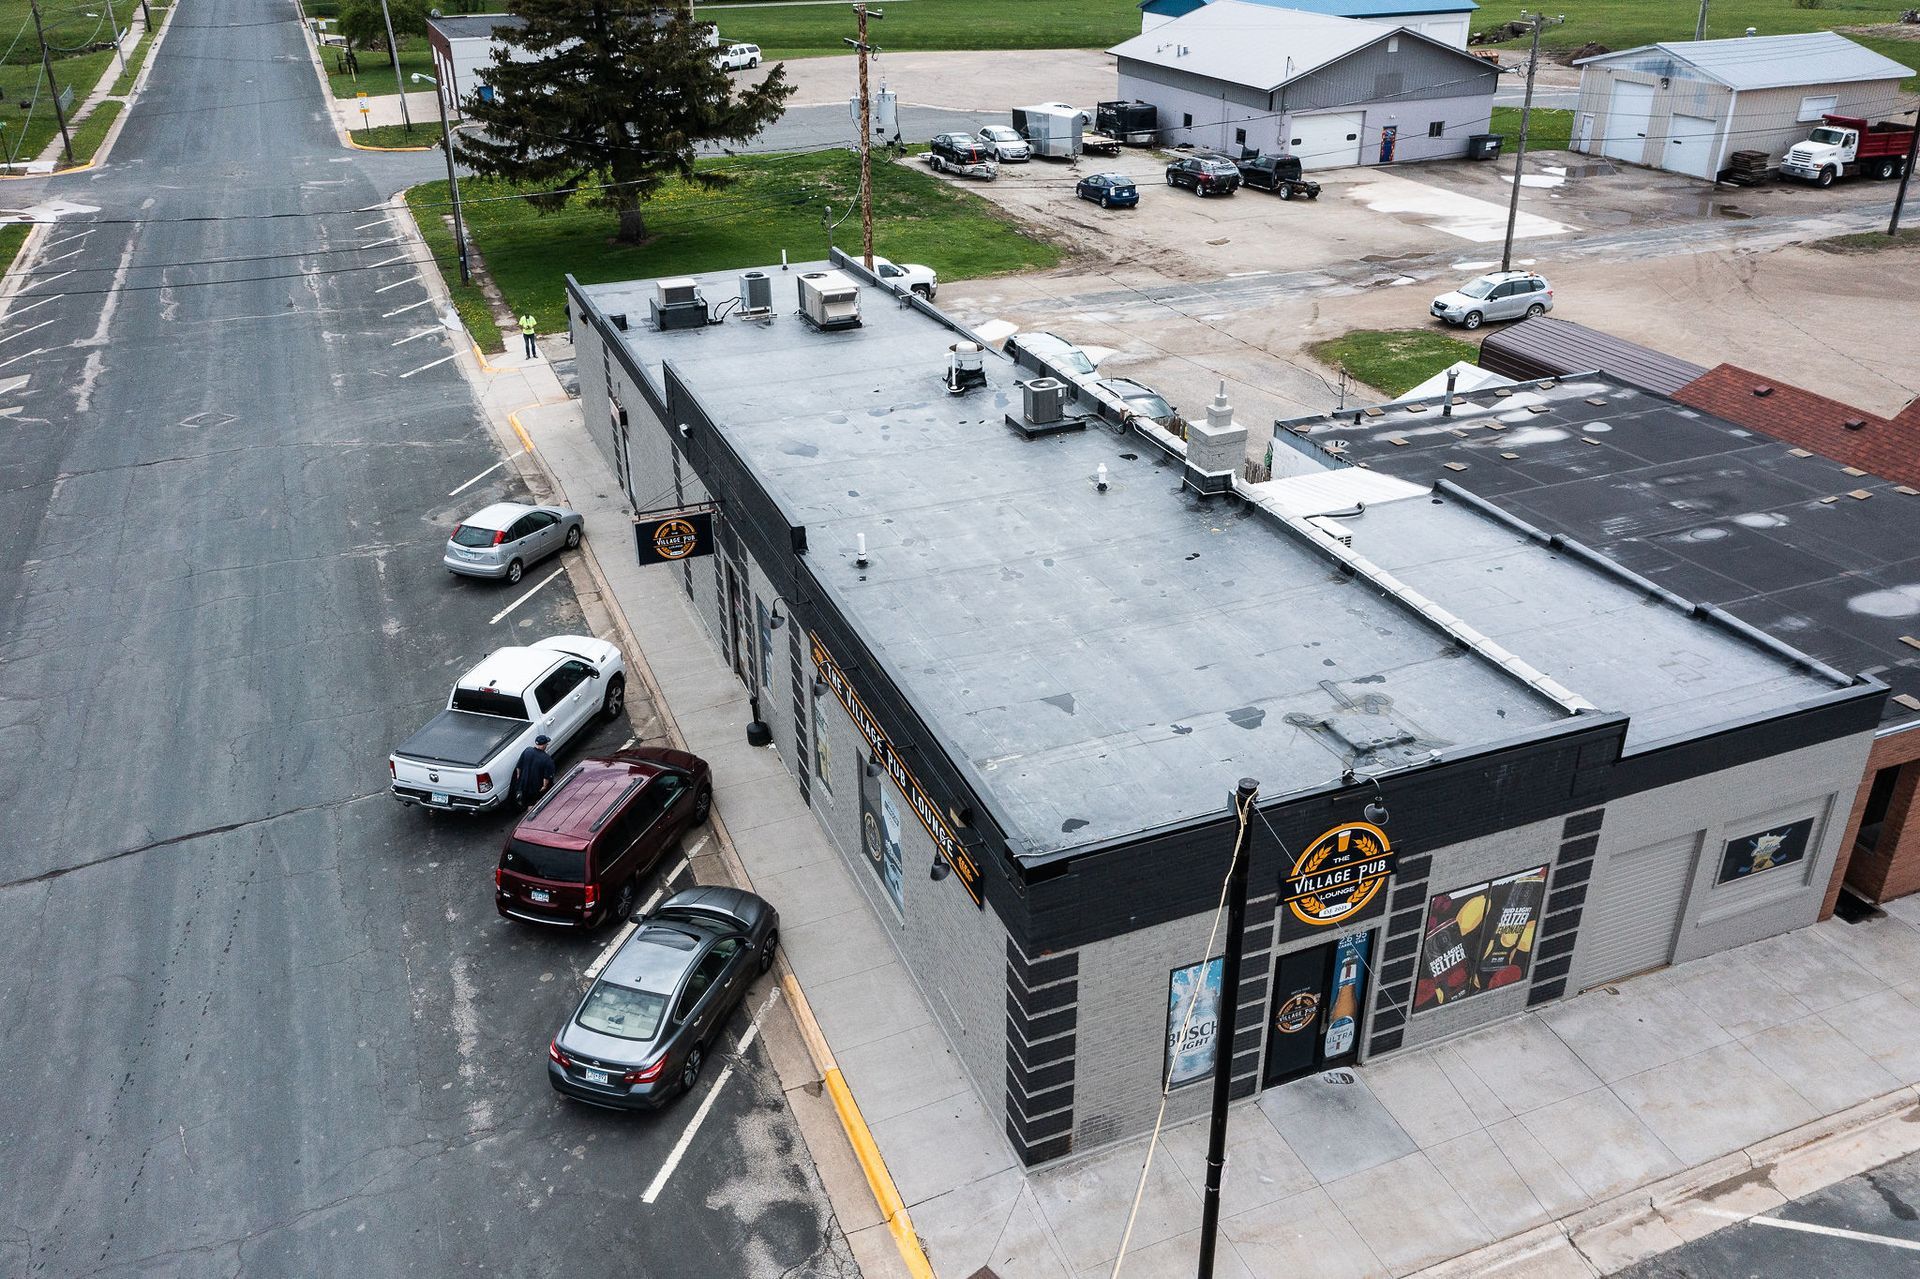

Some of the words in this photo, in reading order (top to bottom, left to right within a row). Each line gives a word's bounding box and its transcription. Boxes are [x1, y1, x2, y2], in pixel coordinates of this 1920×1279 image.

[656, 537, 680, 545] VILLAGE
[683, 535, 695, 544] PUB
[827, 662, 842, 694] THE
[846, 687, 883, 754] VILLAGE
[887, 749, 906, 787] PUB
[912, 787, 954, 858] LOUNGE
[1333, 854, 1351, 864] THE
[1295, 869, 1351, 894] VILLAGE
[1359, 860, 1386, 884] PUB
[1320, 886, 1356, 900] LOUNGE
[1443, 943, 1462, 958] LIGHT
[1431, 948, 1466, 977] SELTZER
[1169, 1020, 1217, 1048] BUSCH
[1326, 1031, 1352, 1043] ULTRA
[1178, 1036, 1210, 1052] IGHT
